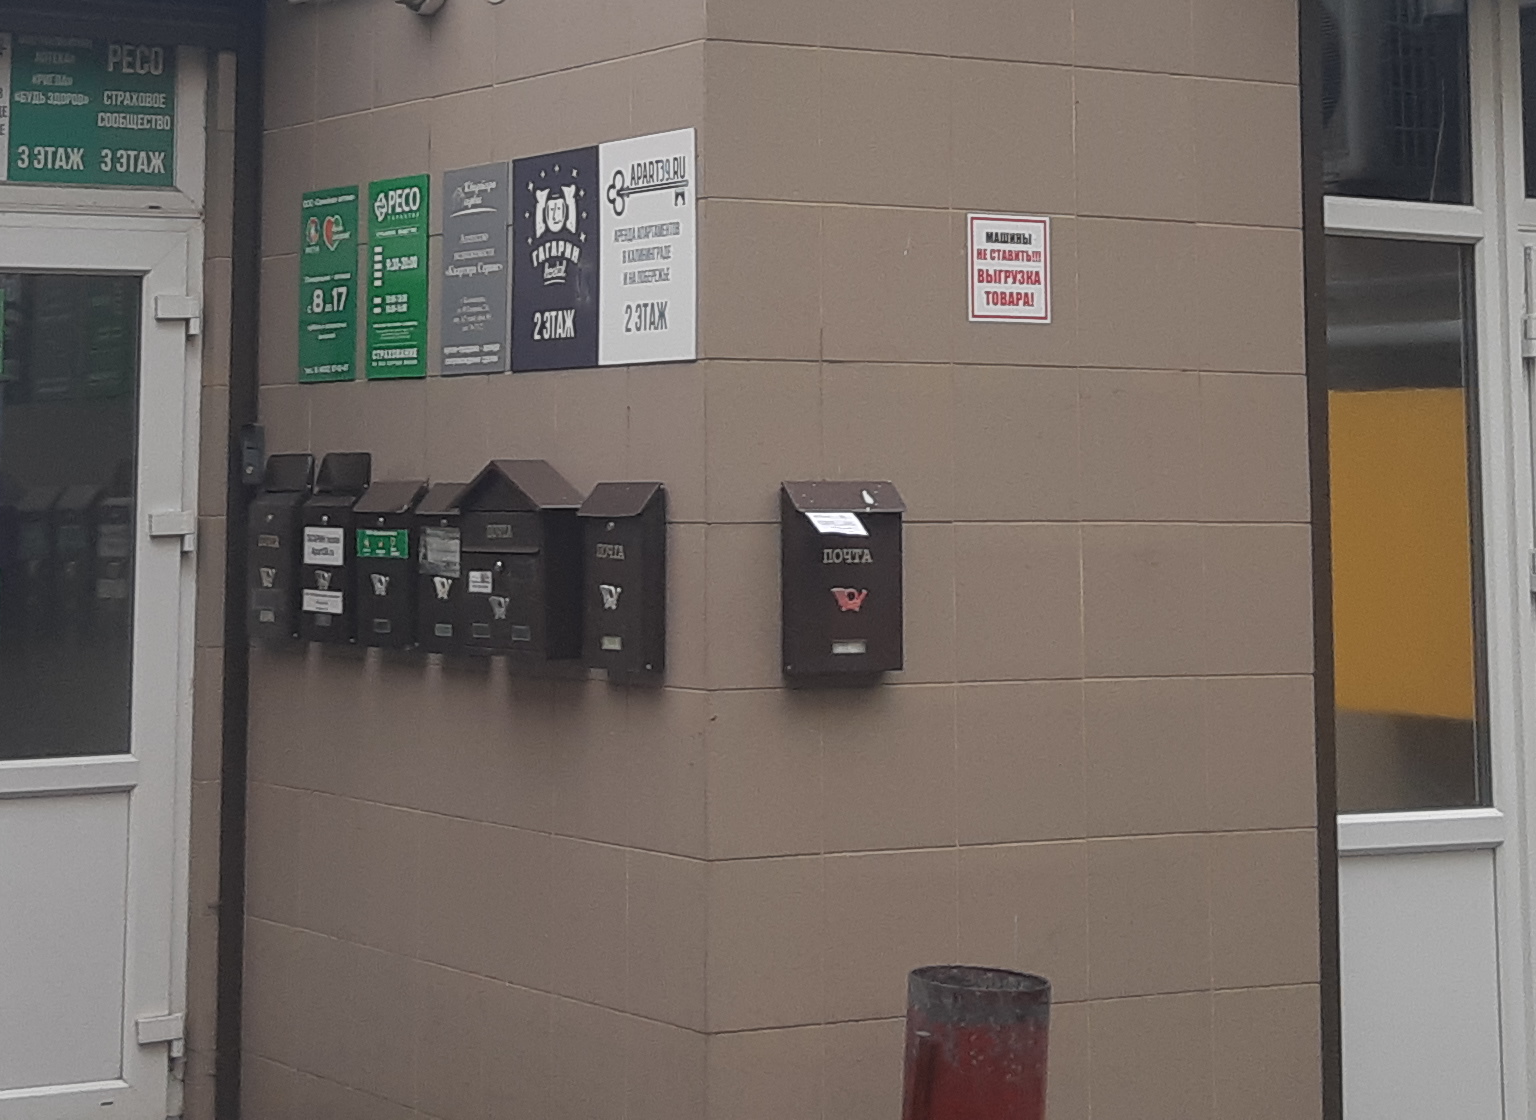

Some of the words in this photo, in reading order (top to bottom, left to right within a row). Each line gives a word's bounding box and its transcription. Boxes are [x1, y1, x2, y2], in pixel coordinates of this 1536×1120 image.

[107, 44, 164, 75] РЕСО
[103, 91, 166, 108] СТРАХОВОЕ
[97, 112, 171, 130] СООБЩЕСТВО
[17, 145, 29, 169] 3
[33, 146, 85, 170] ЭТАЖ
[100, 148, 112, 172] 3
[116, 149, 166, 174] ЭТАЖ
[387, 187, 420, 214] РЕСО
[985, 231, 1032, 245] МАШИНЫ
[531, 240, 580, 268] ГАГАРИН
[976, 248, 988, 261] НЕ
[989, 248, 1042, 263] СТАВИТЬ!!!
[976, 268, 1042, 286] ВЫГРУЗКА
[312, 288, 324, 314] 8
[332, 286, 348, 312] 17
[984, 290, 1035, 307] ТОВАРА!
[533, 311, 542, 340] 2
[543, 309, 576, 340] ЭТАЖ
[624, 304, 633, 333] 2
[635, 301, 668, 331] ЭТАЖ
[822, 548, 874, 564] ПОЧТА
